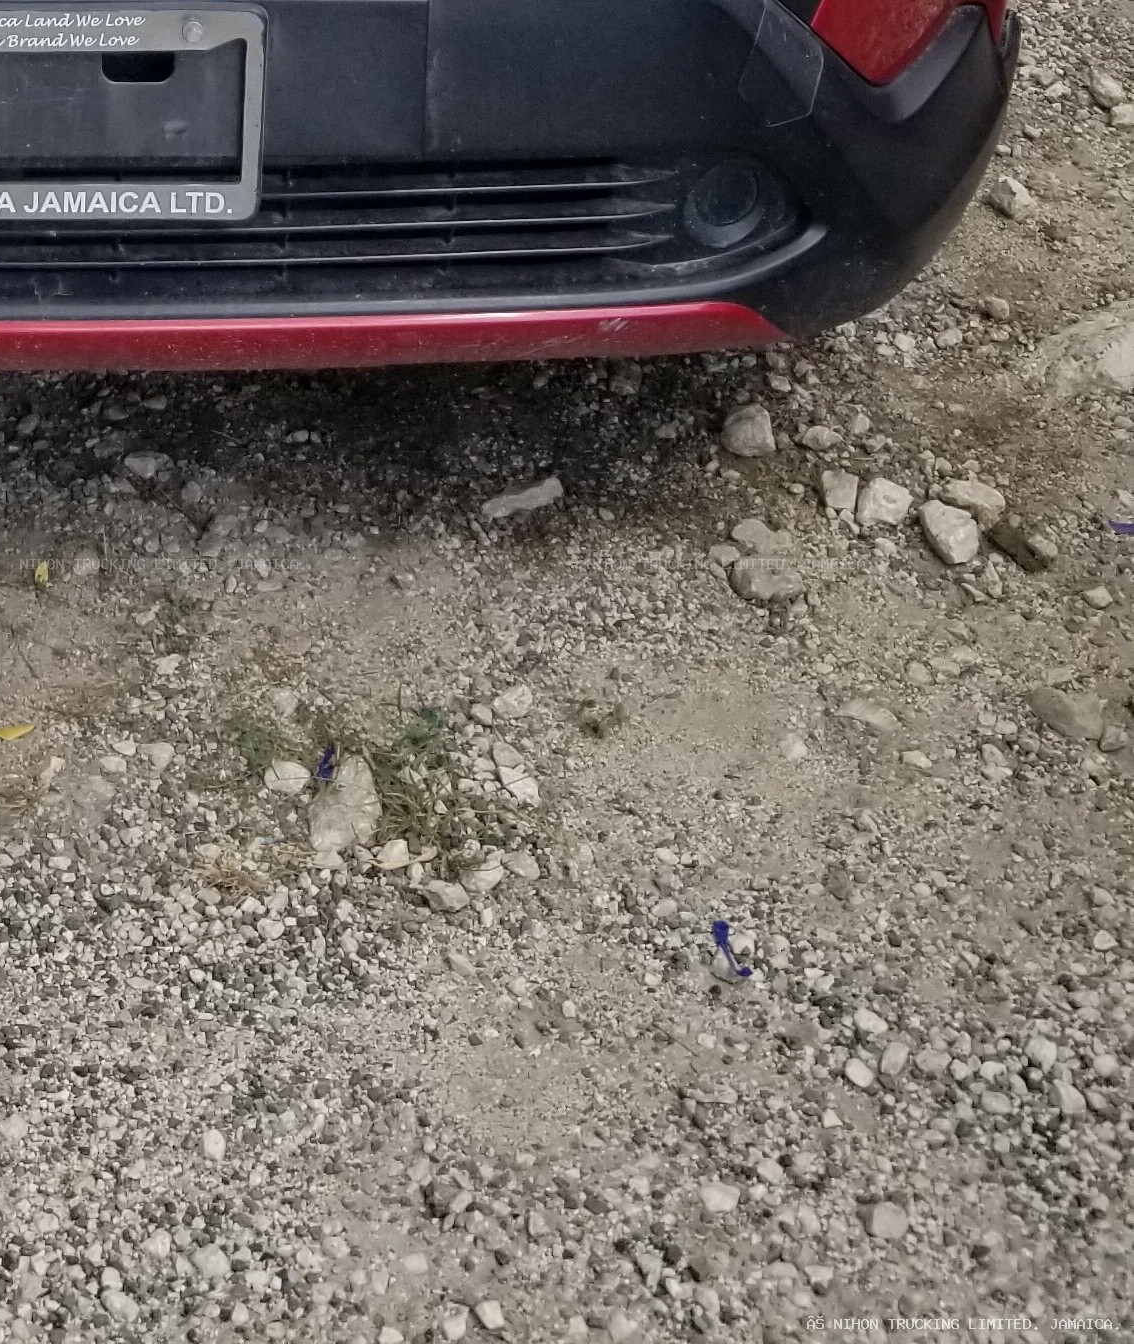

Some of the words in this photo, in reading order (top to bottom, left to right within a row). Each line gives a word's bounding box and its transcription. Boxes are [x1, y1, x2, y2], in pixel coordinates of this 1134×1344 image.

[25, 13, 75, 28] Land
[76, 13, 104, 27] We
[106, 13, 146, 27] Love
[7, 32, 68, 48] Brand
[69, 33, 98, 47] We
[99, 33, 140, 47] Love
[23, 191, 162, 214] JAMAICA
[170, 191, 233, 214] LTD.
